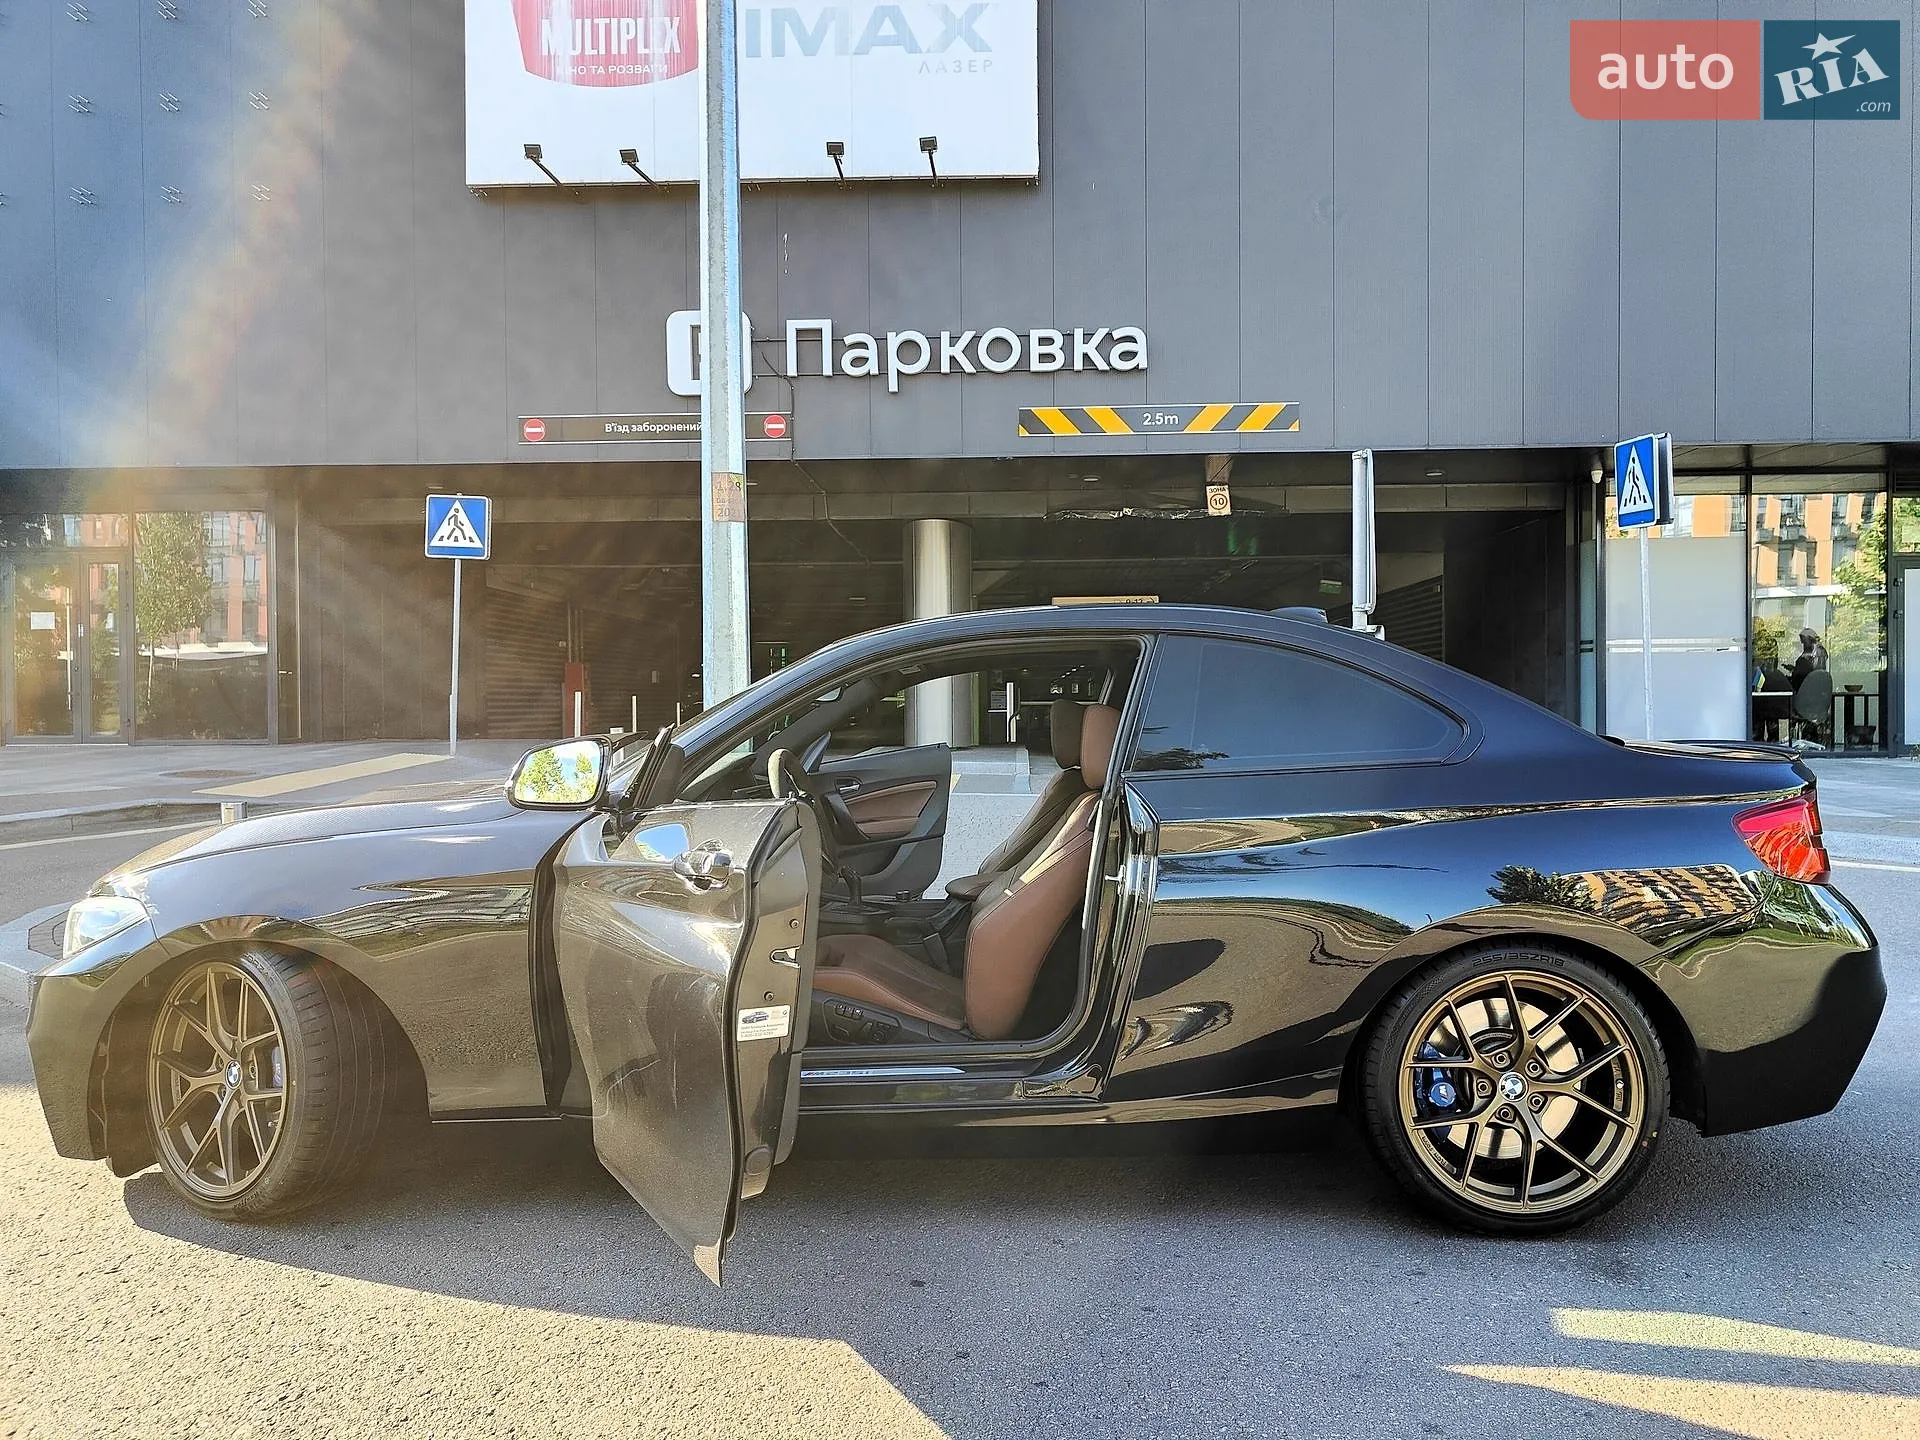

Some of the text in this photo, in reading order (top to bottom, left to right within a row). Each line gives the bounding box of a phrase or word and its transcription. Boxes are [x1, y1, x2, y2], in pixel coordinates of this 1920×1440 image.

[745, 2, 993, 58] IMAX
[588, 65, 605, 75] ТА
[918, 59, 993, 74] ЛАЗЕР
[785, 318, 1148, 393] Парковка
[1142, 411, 1179, 426] 2.5m
[630, 421, 702, 434] заборонений
[1213, 497, 1224, 505] 10
[1472, 952, 1565, 967] 255/35ZR18
